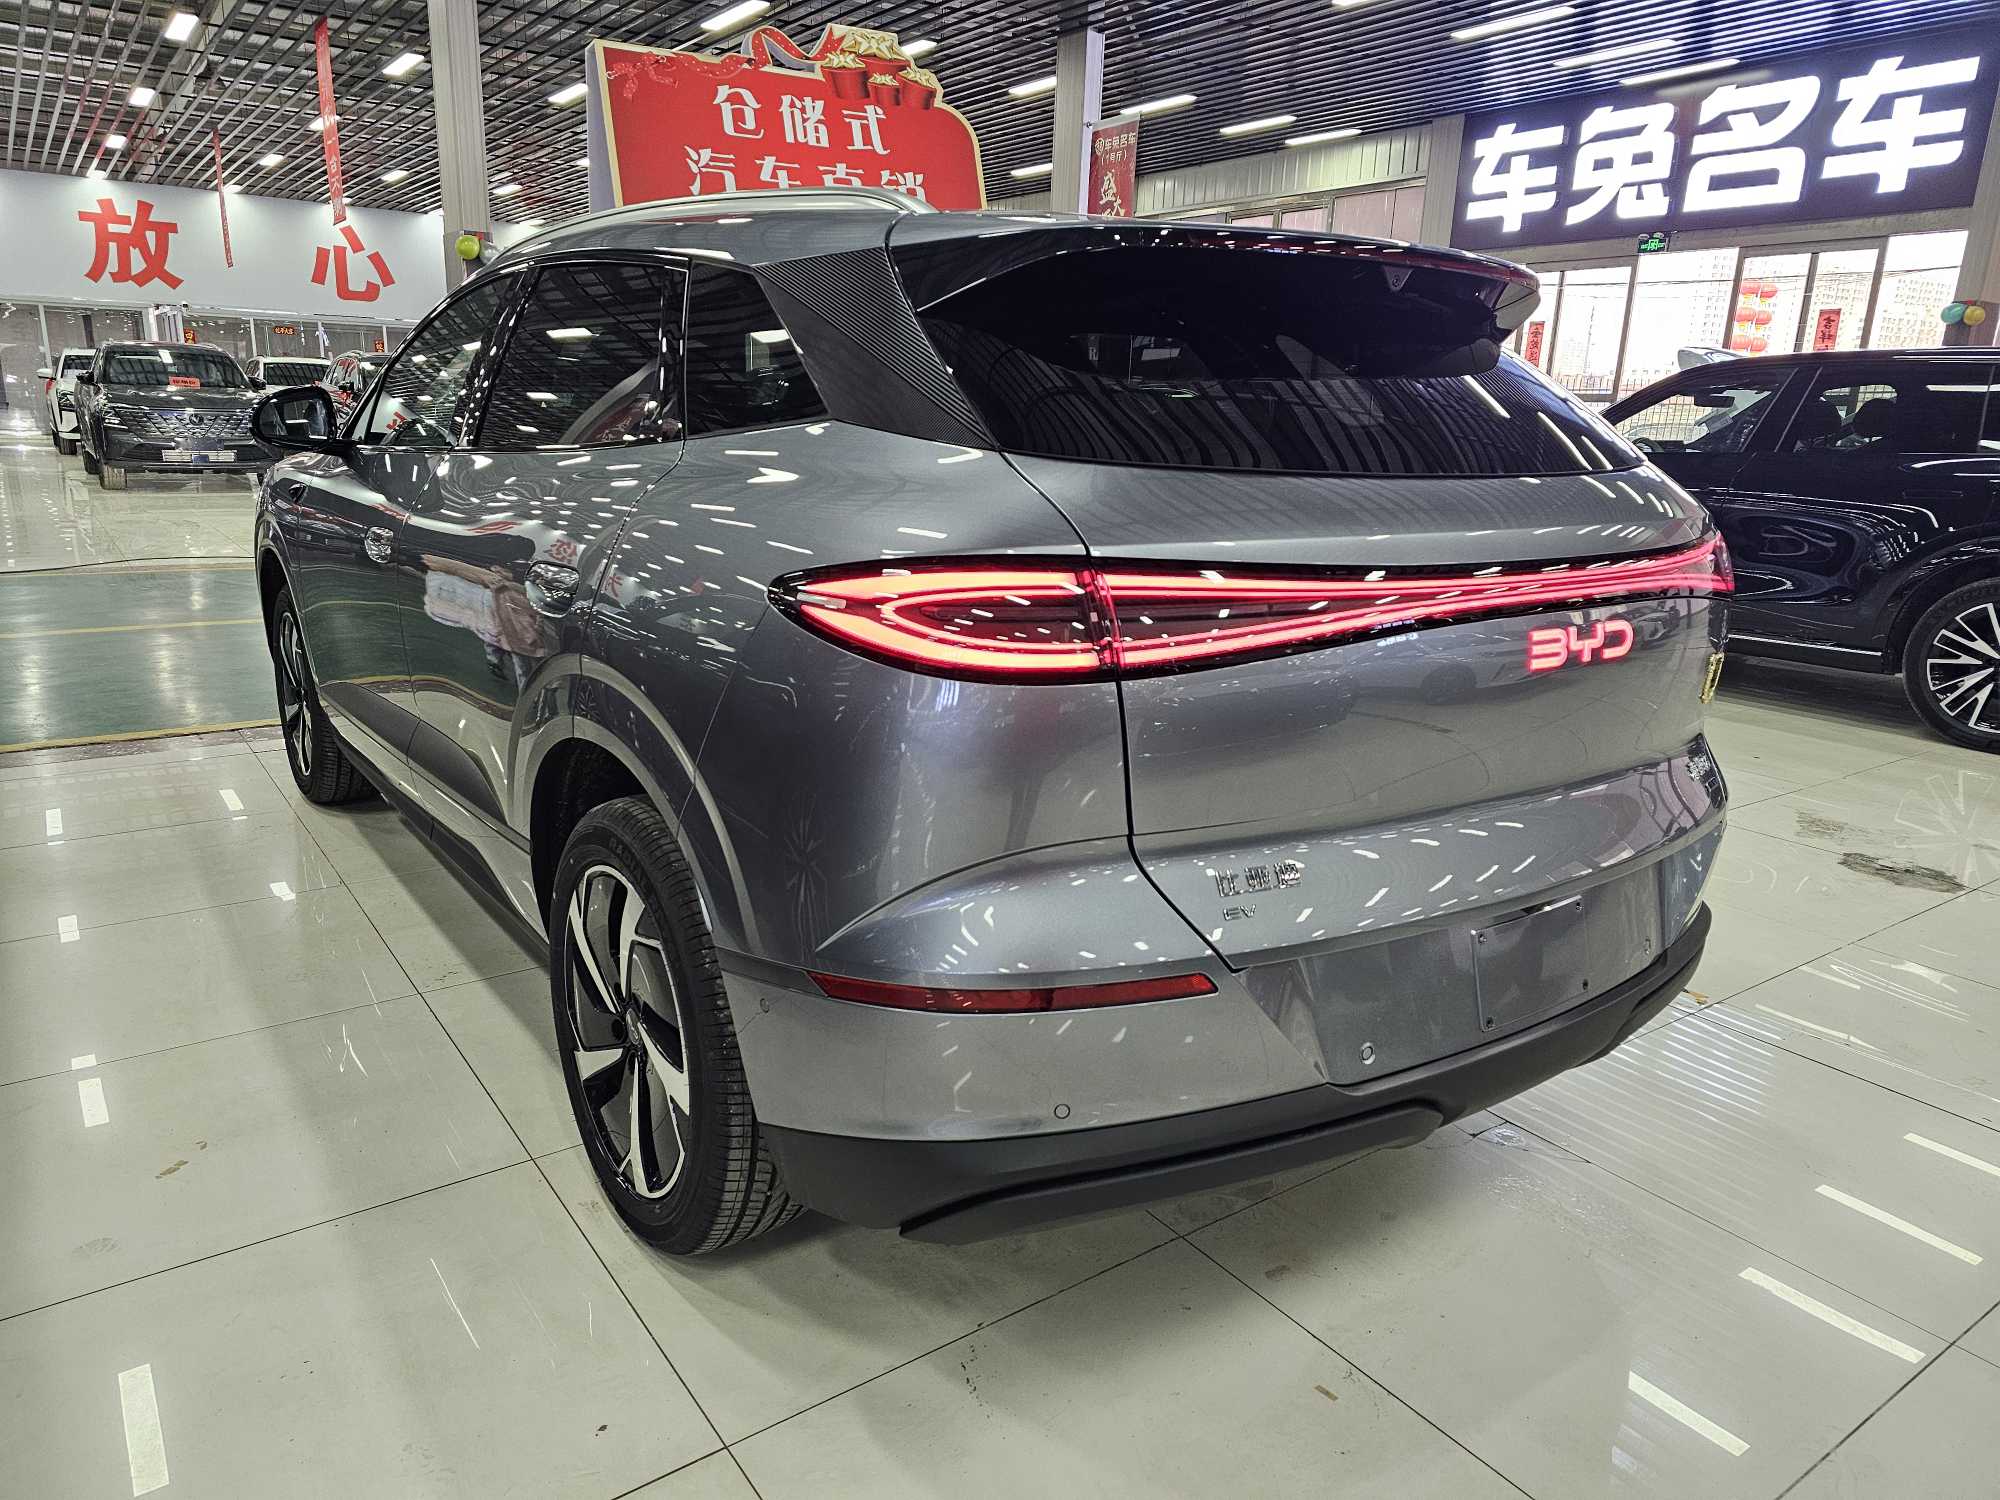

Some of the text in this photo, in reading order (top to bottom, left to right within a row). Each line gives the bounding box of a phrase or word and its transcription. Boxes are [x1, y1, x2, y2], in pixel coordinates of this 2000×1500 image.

[712, 84, 890, 155] 仓储式
[1466, 55, 1981, 232] 车兔名车
[78, 197, 395, 302] 放心
[1528, 619, 1634, 671] BYD
[1215, 862, 1301, 897] 比亚迪
[1223, 904, 1256, 921] EV
